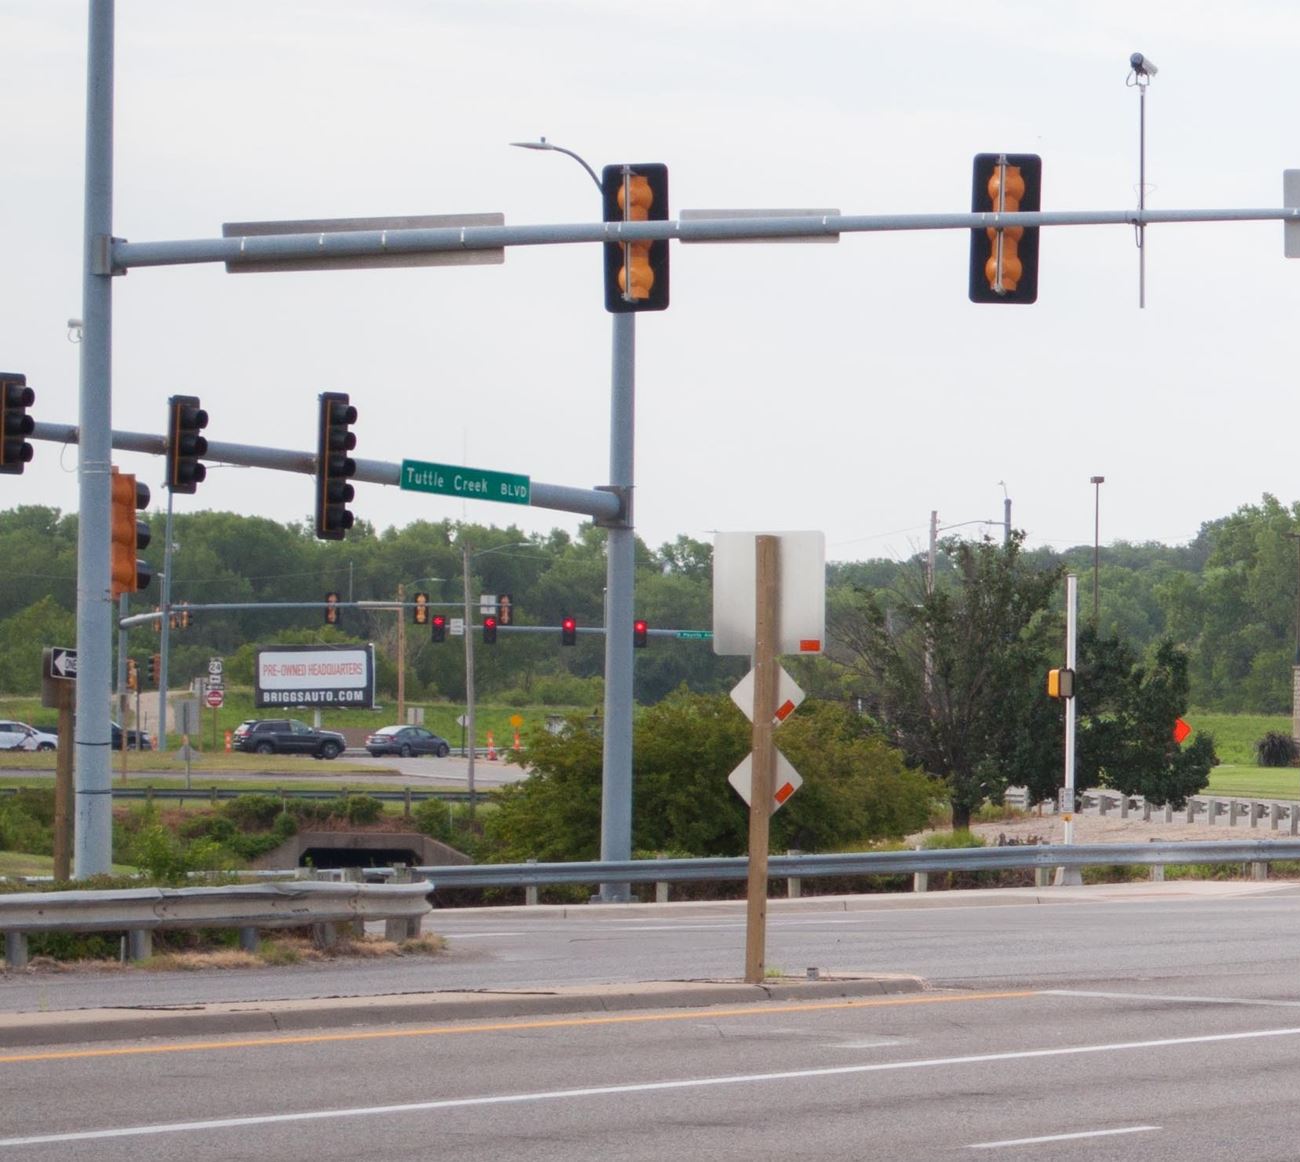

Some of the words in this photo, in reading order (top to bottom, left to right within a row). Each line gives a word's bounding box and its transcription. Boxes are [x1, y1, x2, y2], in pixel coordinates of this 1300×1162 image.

[406, 467, 444, 488] Tuttle
[454, 475, 488, 493] Creek
[500, 483, 527, 498] BLVD
[262, 664, 306, 677] PRE-OWNED
[308, 663, 363, 676] HEADQUARTERS
[263, 690, 363, 702] BRIGGSAUTO.COM
